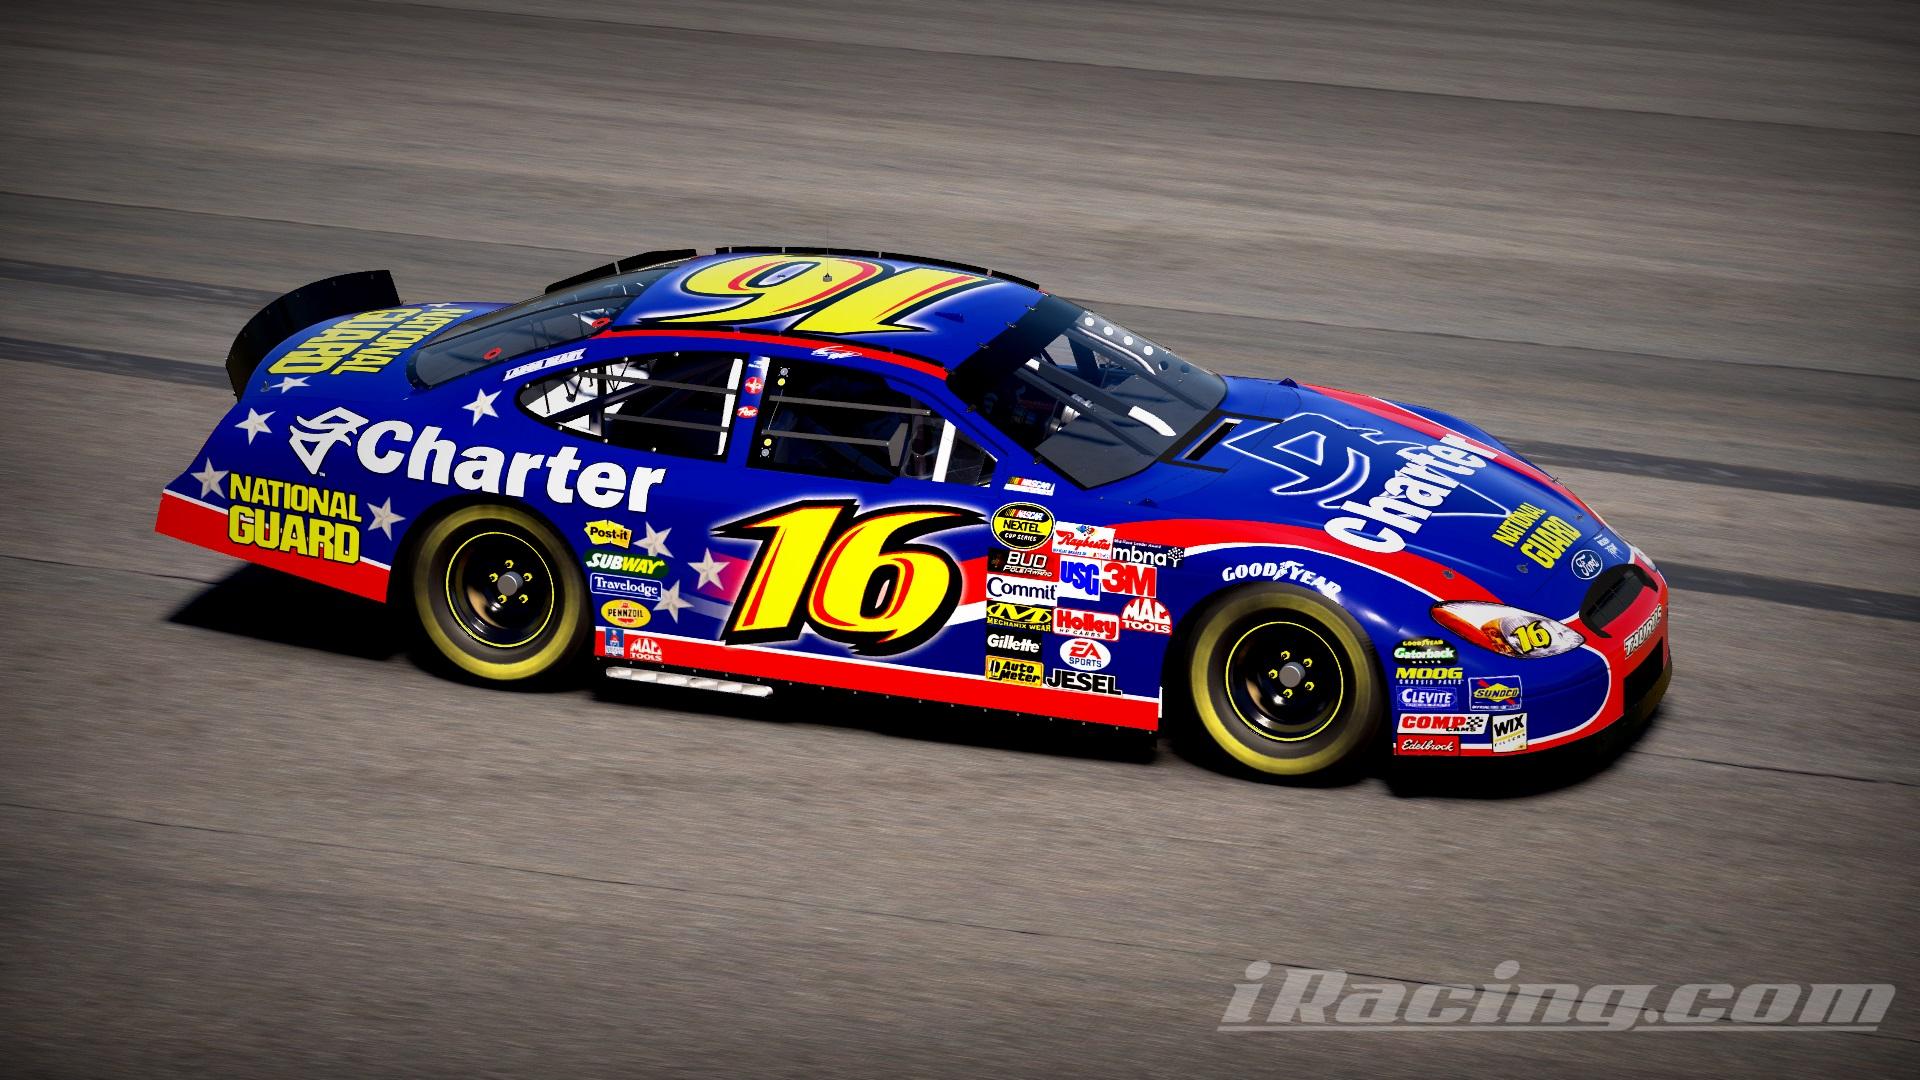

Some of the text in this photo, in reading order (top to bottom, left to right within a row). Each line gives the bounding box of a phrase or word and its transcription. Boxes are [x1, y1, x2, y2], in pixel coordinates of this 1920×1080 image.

[268, 308, 423, 374] GUARD
[330, 309, 473, 374] NATIONAL
[356, 419, 667, 513] Charter
[229, 473, 362, 523] NATIONAL
[1324, 433, 1499, 553] Charter
[1016, 510, 1043, 520] NASCAR
[228, 507, 360, 565] GUARD
[590, 526, 628, 541] Post-it
[1003, 520, 1040, 532] NEXTEL
[1520, 515, 1582, 569] GUARD
[586, 553, 665, 574] SUBWAY
[1007, 551, 1047, 568] BUD
[1112, 546, 1167, 566] mbna
[1575, 553, 1599, 576] Ford
[594, 576, 658, 597] Travelodge
[713, 499, 987, 657] 16
[1061, 561, 1100, 595] USG
[1102, 562, 1156, 597] 3M
[1222, 561, 1342, 605] GOODYEAR
[987, 577, 1056, 600] Commit
[608, 608, 643, 618] PENNZOIL
[1123, 598, 1170, 624] MAC
[987, 616, 1051, 632] MECHANIX WEAR
[1056, 610, 1118, 640] Holley
[1122, 620, 1171, 633] TOOLS
[630, 638, 662, 654] MAC
[988, 634, 1040, 653] Gillette
[1511, 620, 1552, 655] 16
[631, 653, 662, 661] TOOLS
[1069, 641, 1101, 659] EA
[1394, 647, 1455, 659] Gatorback
[1003, 661, 1034, 673] Auto
[1069, 657, 1102, 668] SPORTS
[1000, 670, 1040, 682] Meter
[1047, 670, 1122, 695] JESEL
[1396, 667, 1463, 679] MOOG
[1401, 688, 1453, 703] CLEVITE
[1477, 688, 1518, 698] SUNOCO
[1402, 716, 1466, 729] COMP
[1494, 715, 1524, 736] WIX
[1402, 739, 1454, 751] Edelbrock
